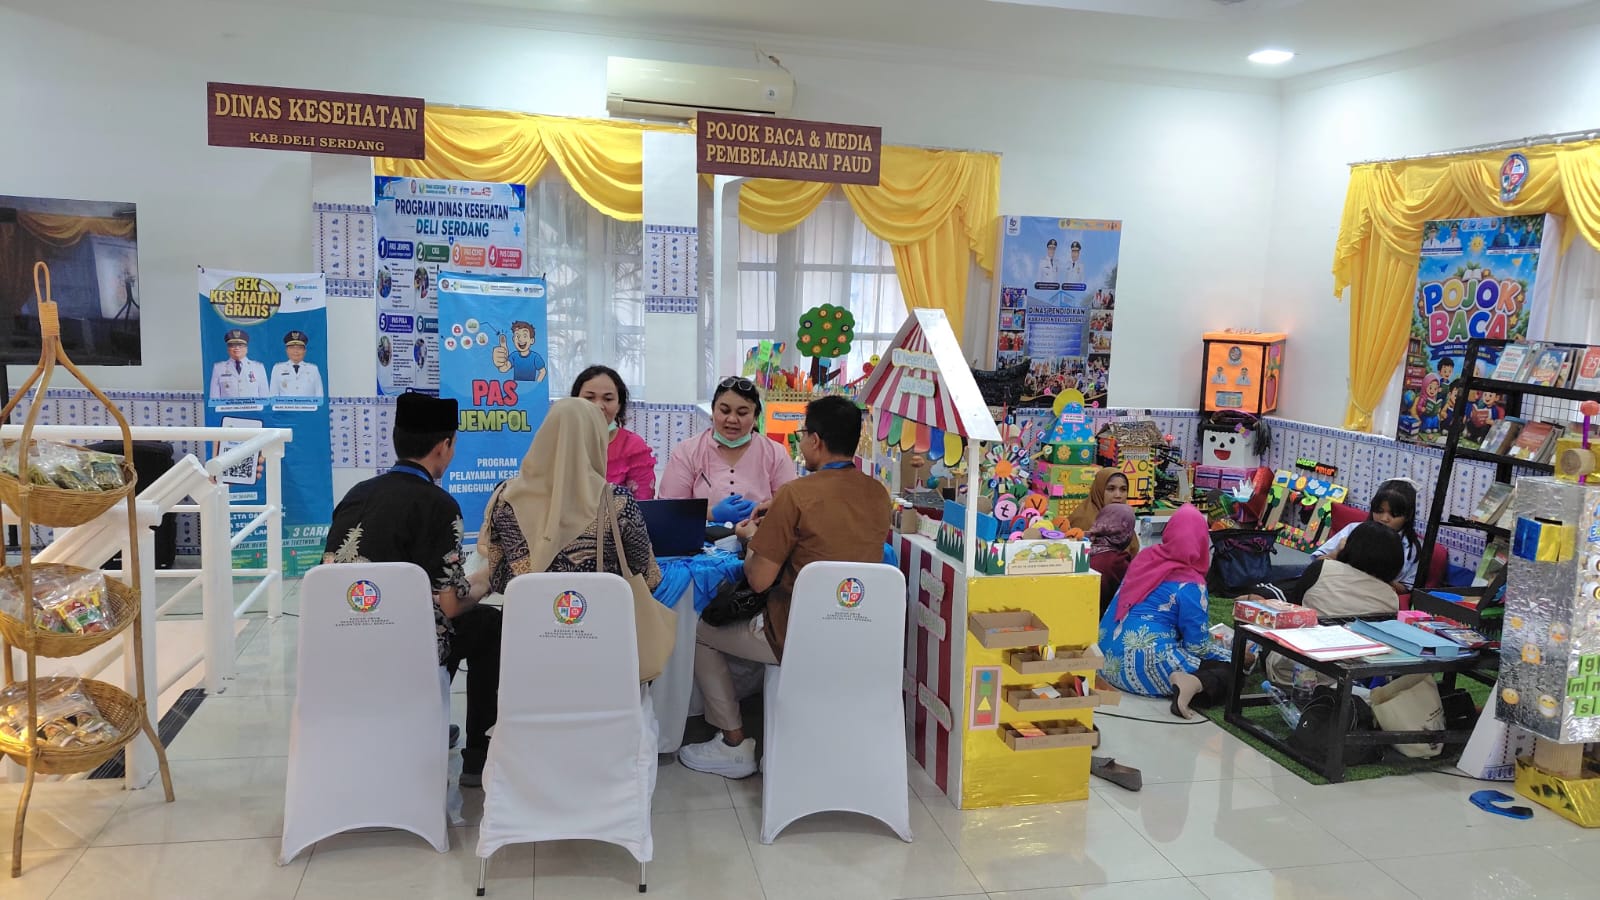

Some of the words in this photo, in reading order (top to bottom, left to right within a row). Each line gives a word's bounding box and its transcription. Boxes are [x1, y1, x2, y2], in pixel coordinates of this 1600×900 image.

[215, 92, 282, 120] DINAS
[288, 98, 418, 130] KESEHATAN
[249, 132, 315, 146] KAB.DELI
[319, 137, 385, 151] SERDANG
[706, 121, 760, 143] POJOK
[764, 126, 805, 147] BACA
[809, 130, 821, 148] &
[825, 131, 873, 152] MEDIA
[706, 143, 828, 171] PEMBELAJARAN
[833, 154, 872, 173] PAUD
[395, 198, 436, 216] PROGRAM
[439, 201, 463, 218] DINAS
[465, 203, 509, 219] KESEHATAN
[416, 218, 439, 235] DELI
[441, 220, 489, 237] SERDANG
[417, 244, 423, 259] 2
[454, 246, 460, 261] 3
[489, 248, 495, 263] 4
[234, 278, 260, 291] CEK
[210, 290, 280, 305] KESEHATAN
[1422, 278, 1522, 316] POJOK
[224, 304, 271, 318] GRATIS
[380, 314, 386, 329] 5
[1428, 310, 1507, 346] BACA
[471, 379, 519, 406] PAS
[458, 409, 531, 432] JEMPOL
[477, 458, 518, 468] PROGRAM
[449, 471, 496, 481] PELAYANAN
[1000, 503, 1009, 518] t
[292, 528, 301, 537] 3
[302, 526, 330, 537] CARA
[1584, 657, 1595, 673] g
[1571, 681, 1584, 693] m
[1580, 703, 1590, 714] s
